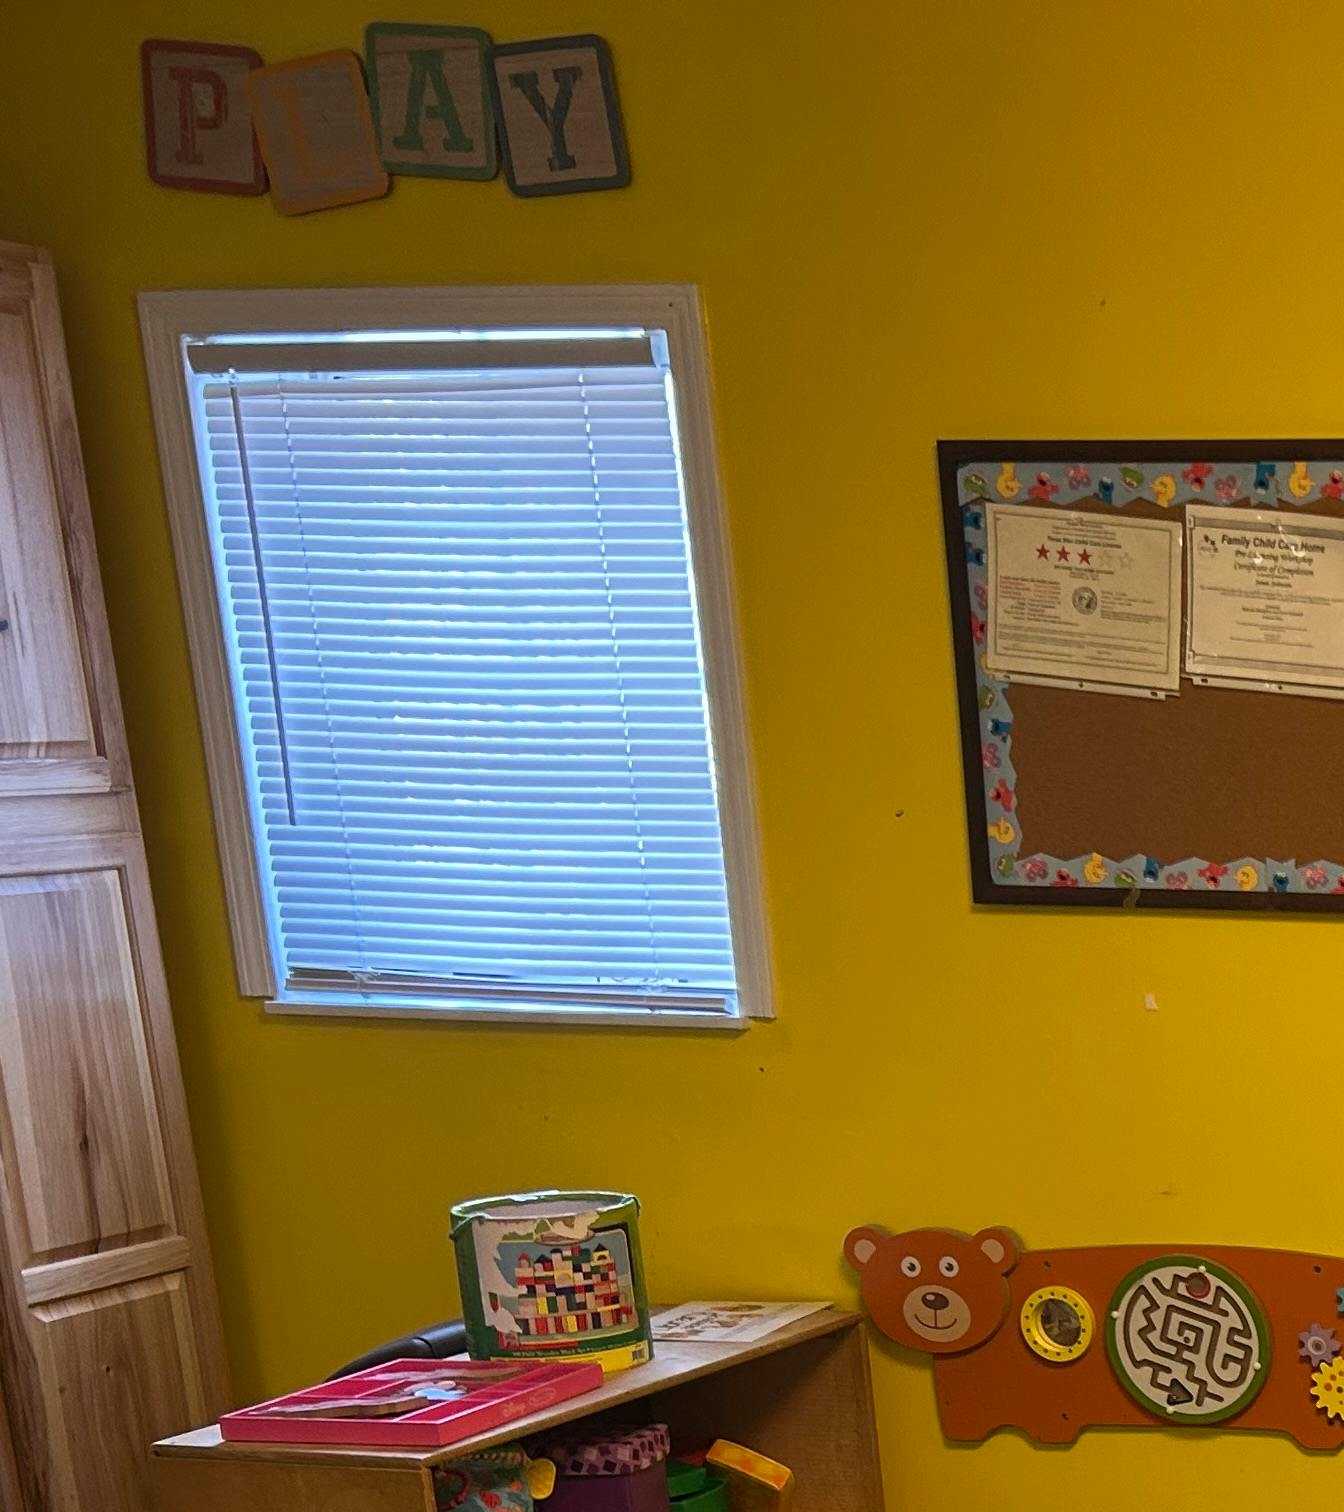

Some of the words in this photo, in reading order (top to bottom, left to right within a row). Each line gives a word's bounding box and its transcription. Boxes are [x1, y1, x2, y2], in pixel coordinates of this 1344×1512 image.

[169, 49, 582, 181] PLAY
[1222, 535, 1250, 549] Family
[1253, 538, 1276, 548] Child
[1301, 542, 1325, 553] Home
